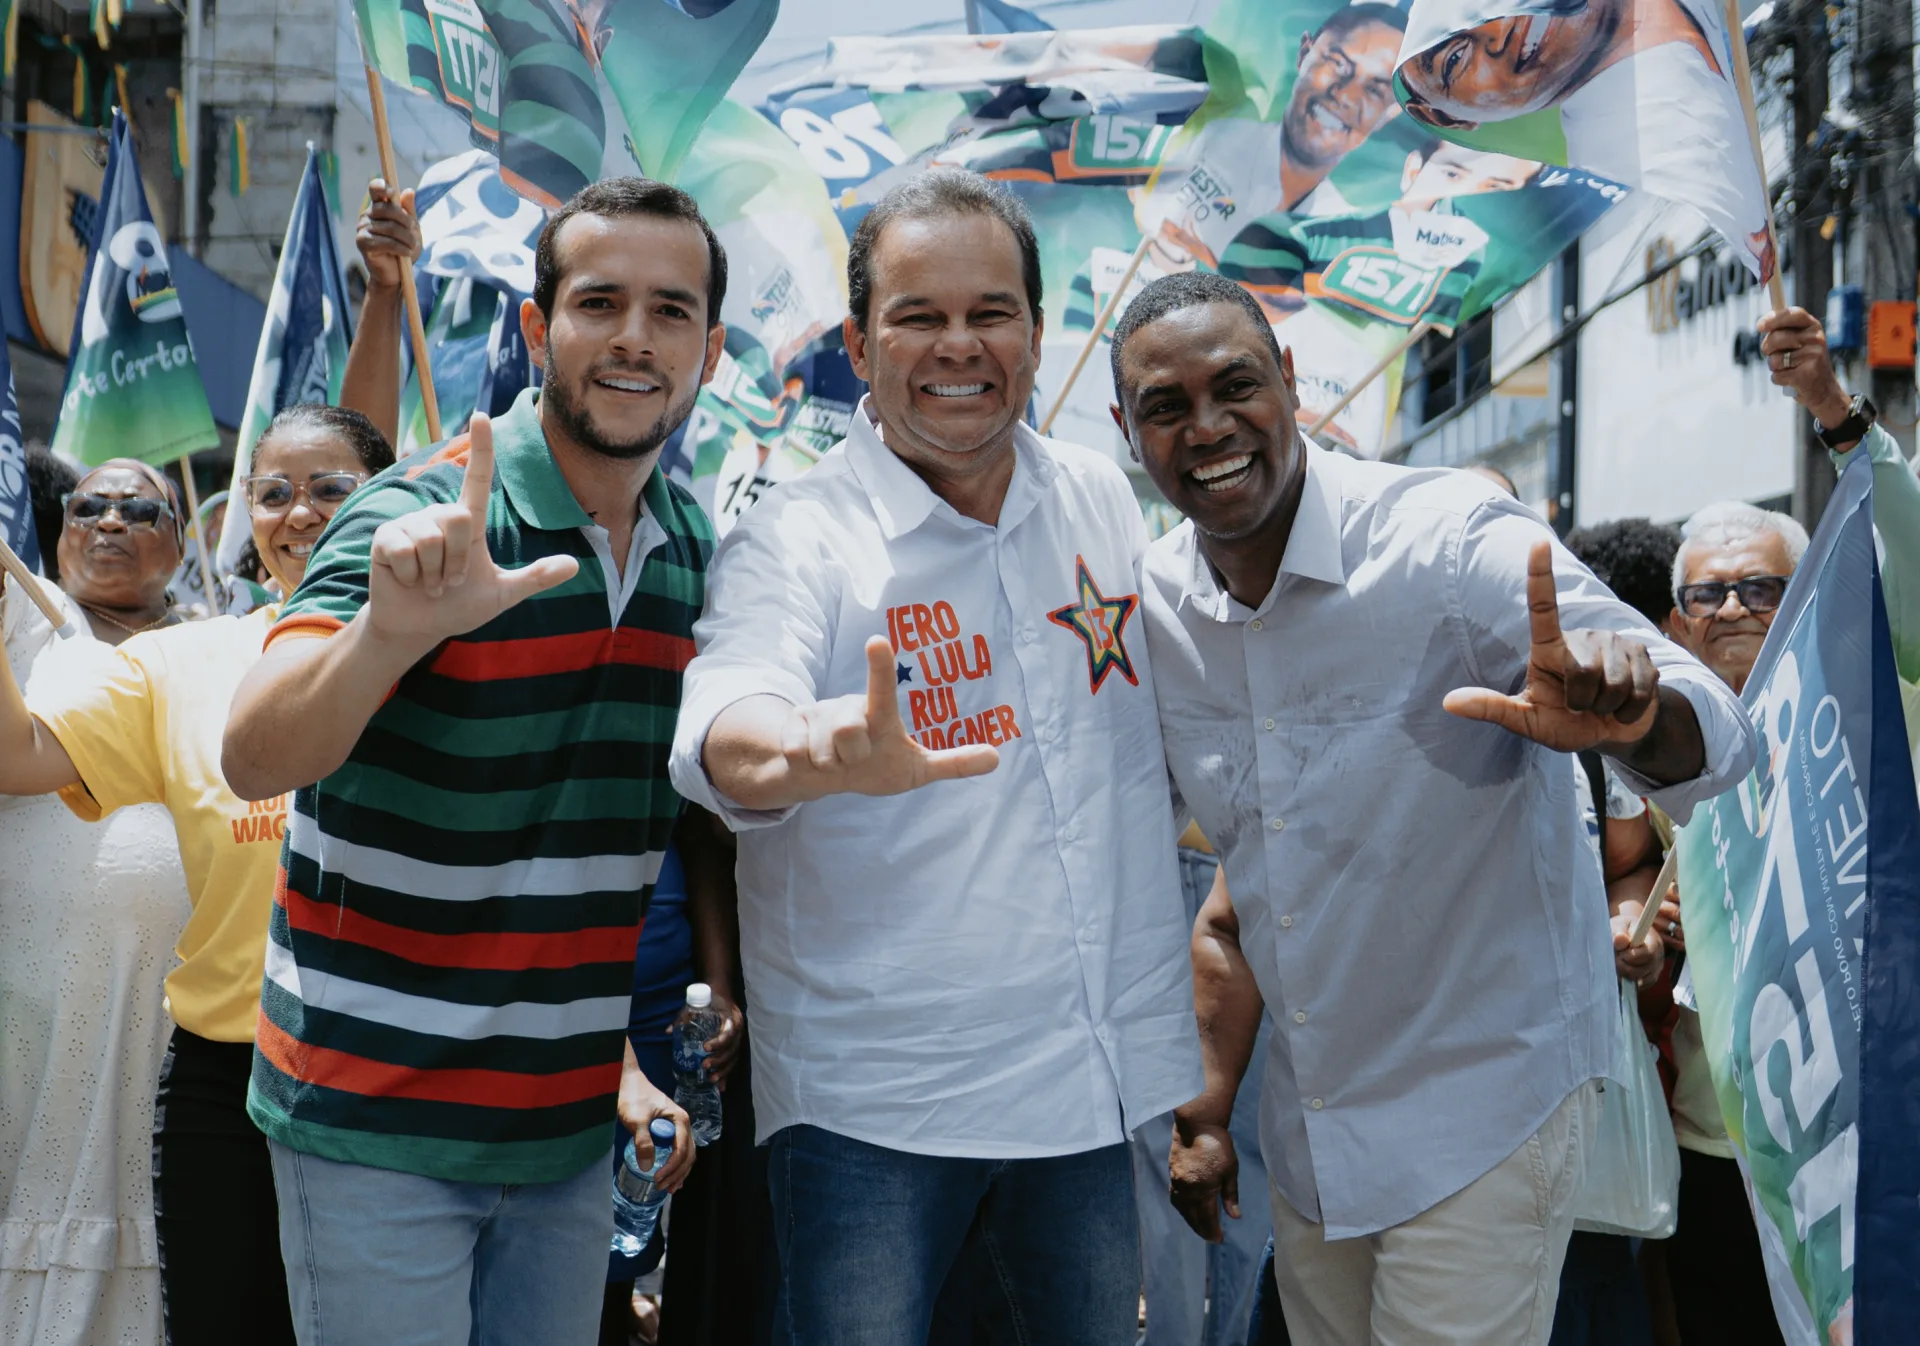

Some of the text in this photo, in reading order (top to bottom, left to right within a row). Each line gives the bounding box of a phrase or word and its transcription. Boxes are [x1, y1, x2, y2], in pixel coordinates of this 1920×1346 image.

[1084, 607, 1114, 650] 13
[917, 634, 992, 686] LULA
[908, 686, 959, 731] RUI
